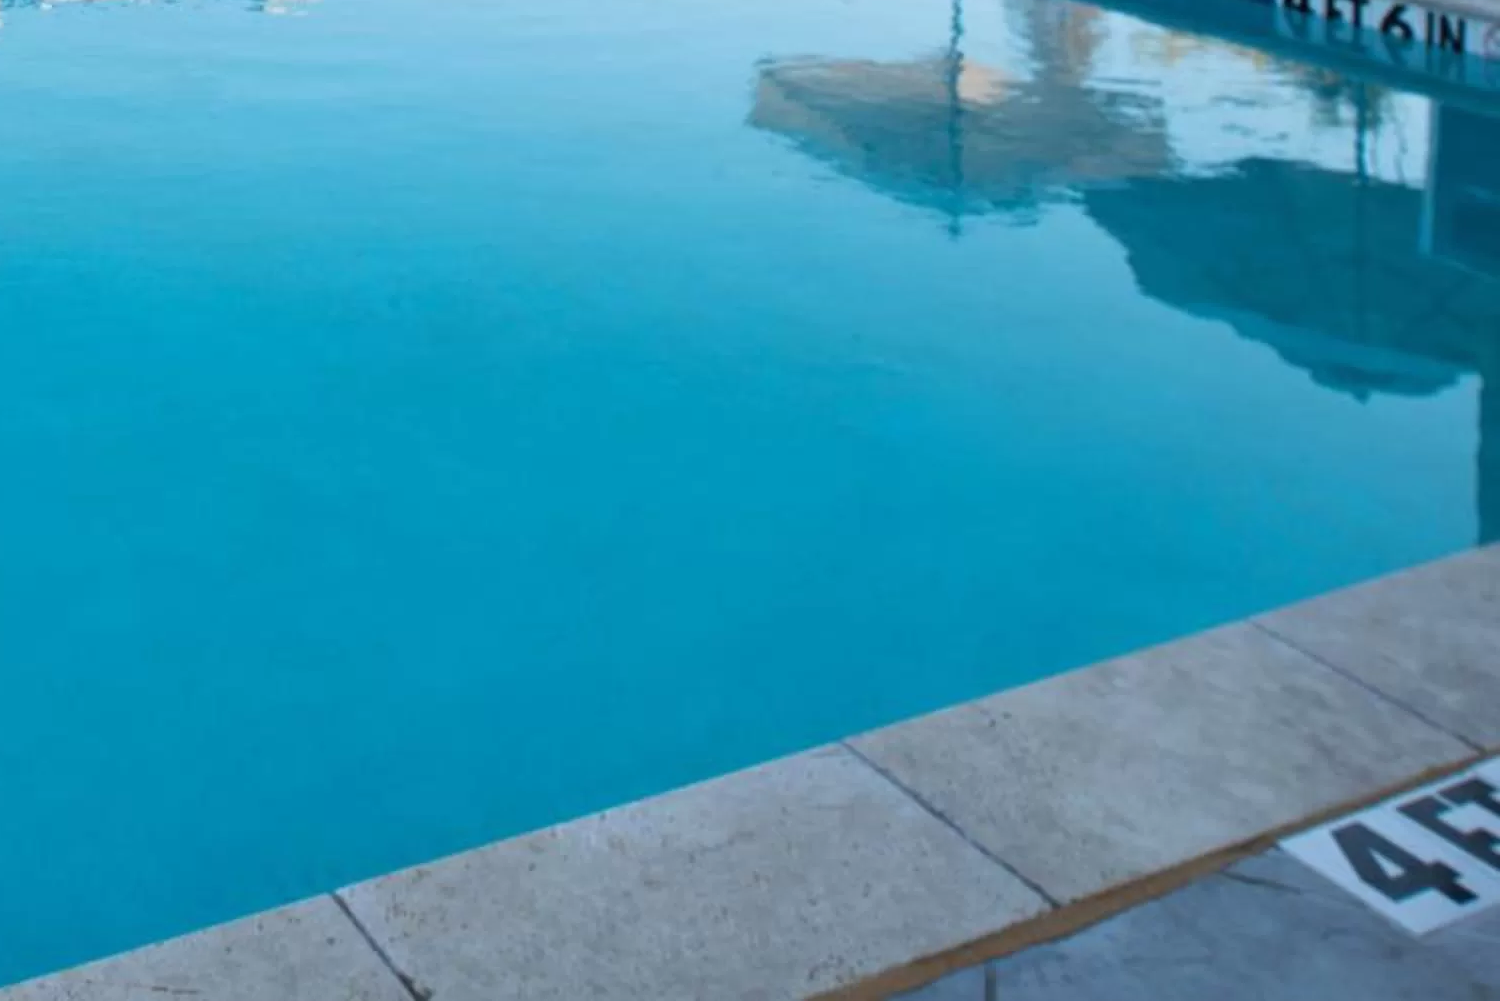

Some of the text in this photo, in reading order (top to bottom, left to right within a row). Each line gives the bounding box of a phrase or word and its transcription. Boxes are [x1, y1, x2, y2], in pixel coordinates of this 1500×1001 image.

[1380, 3, 1414, 43] 6
[1426, 11, 1466, 54] IN
[1331, 820, 1479, 906] 4
